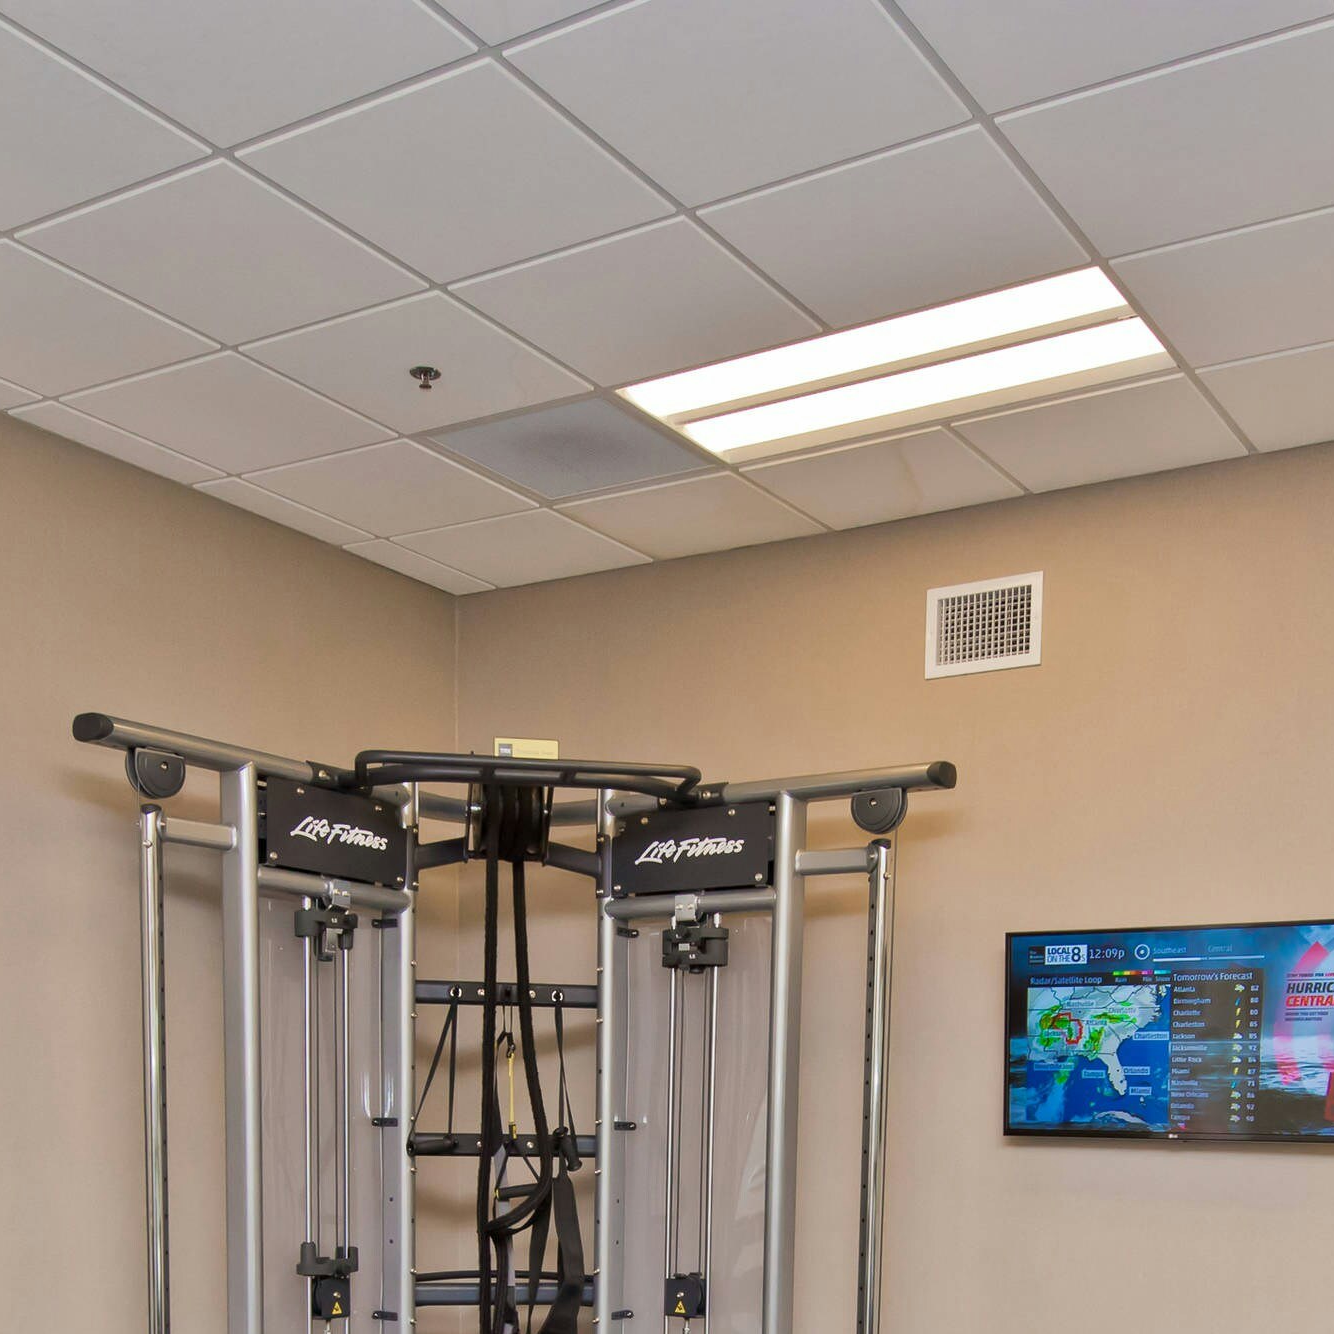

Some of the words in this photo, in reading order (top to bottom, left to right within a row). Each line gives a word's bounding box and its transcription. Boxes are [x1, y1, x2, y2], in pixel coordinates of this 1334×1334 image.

[290, 816, 330, 842] Life
[327, 823, 388, 850] Fitness
[634, 839, 676, 865] Life
[673, 837, 745, 863] Fitness
[1047, 947, 1071, 955] LOCAL
[1088, 948, 1126, 959] 12:09p
[1057, 954, 1071, 962] THE
[1084, 976, 1103, 985] Loop
[1173, 973, 1218, 982] Tomorrow's
[1220, 972, 1253, 980] Forecast
